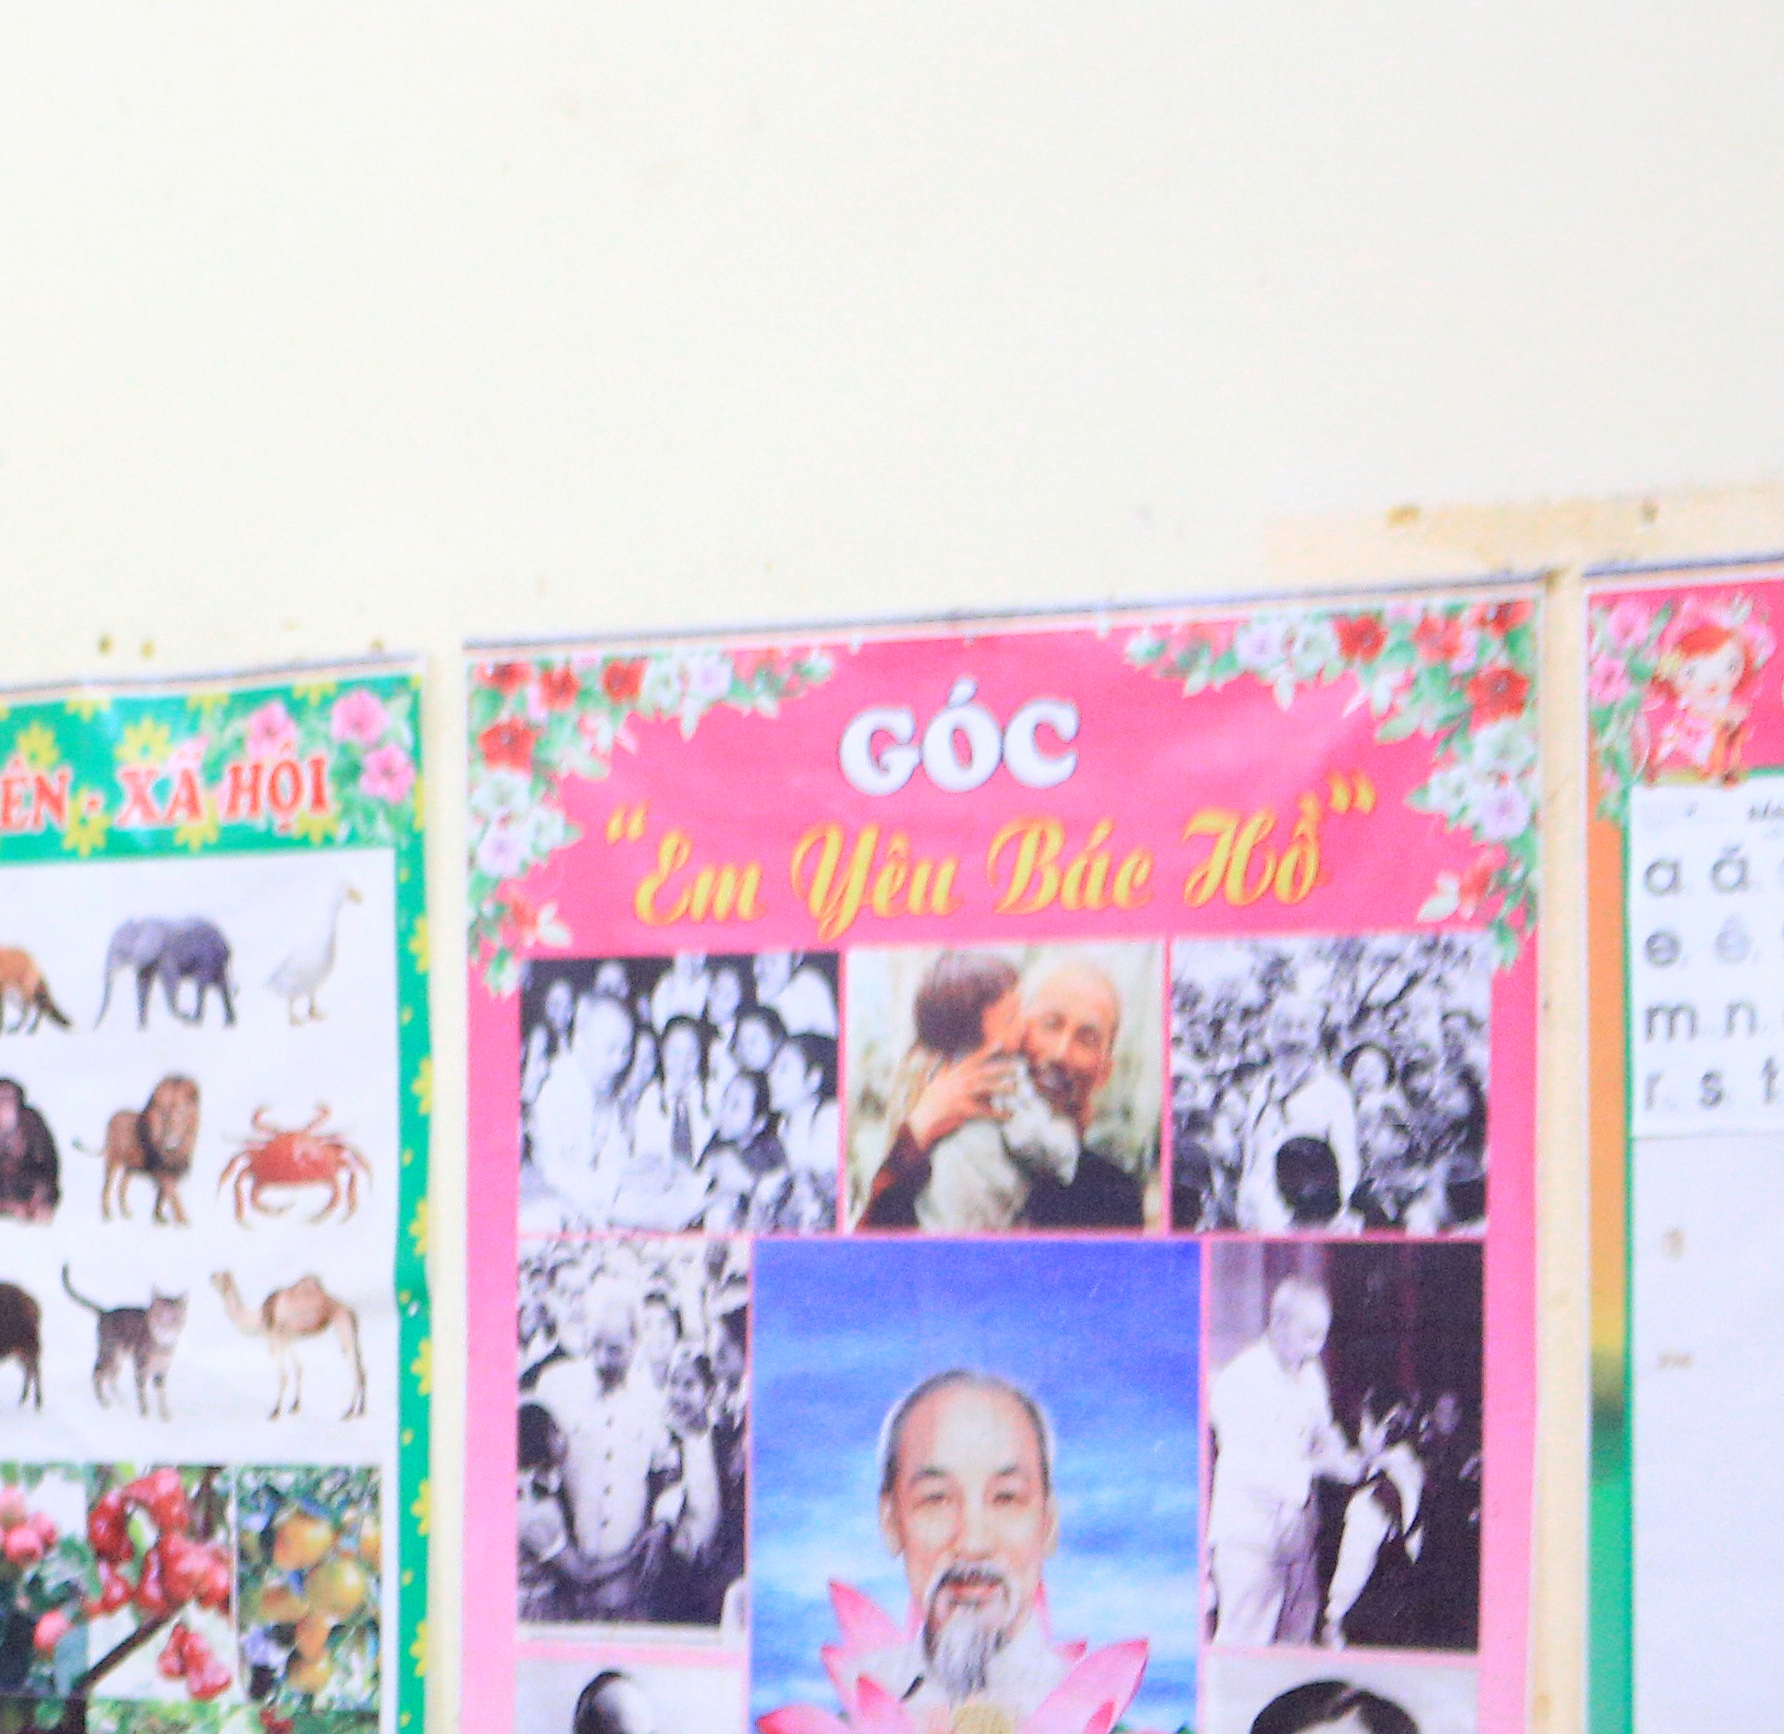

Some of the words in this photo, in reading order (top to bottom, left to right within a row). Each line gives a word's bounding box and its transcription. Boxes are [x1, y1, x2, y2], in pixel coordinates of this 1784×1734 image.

[839, 679, 1081, 795] GÓC
[117, 742, 208, 829] XÃ
[223, 742, 333, 833] HỘI
[790, 819, 965, 943] Yêu
[985, 815, 1154, 917] Bác
[1645, 858, 1682, 895] a
[1645, 930, 1681, 967] e
[1645, 1003, 1699, 1041] m
[1727, 1001, 1757, 1037] n
[1646, 1073, 1663, 1110] r
[1700, 1070, 1723, 1108] s
[1763, 1056, 1779, 1104] t
